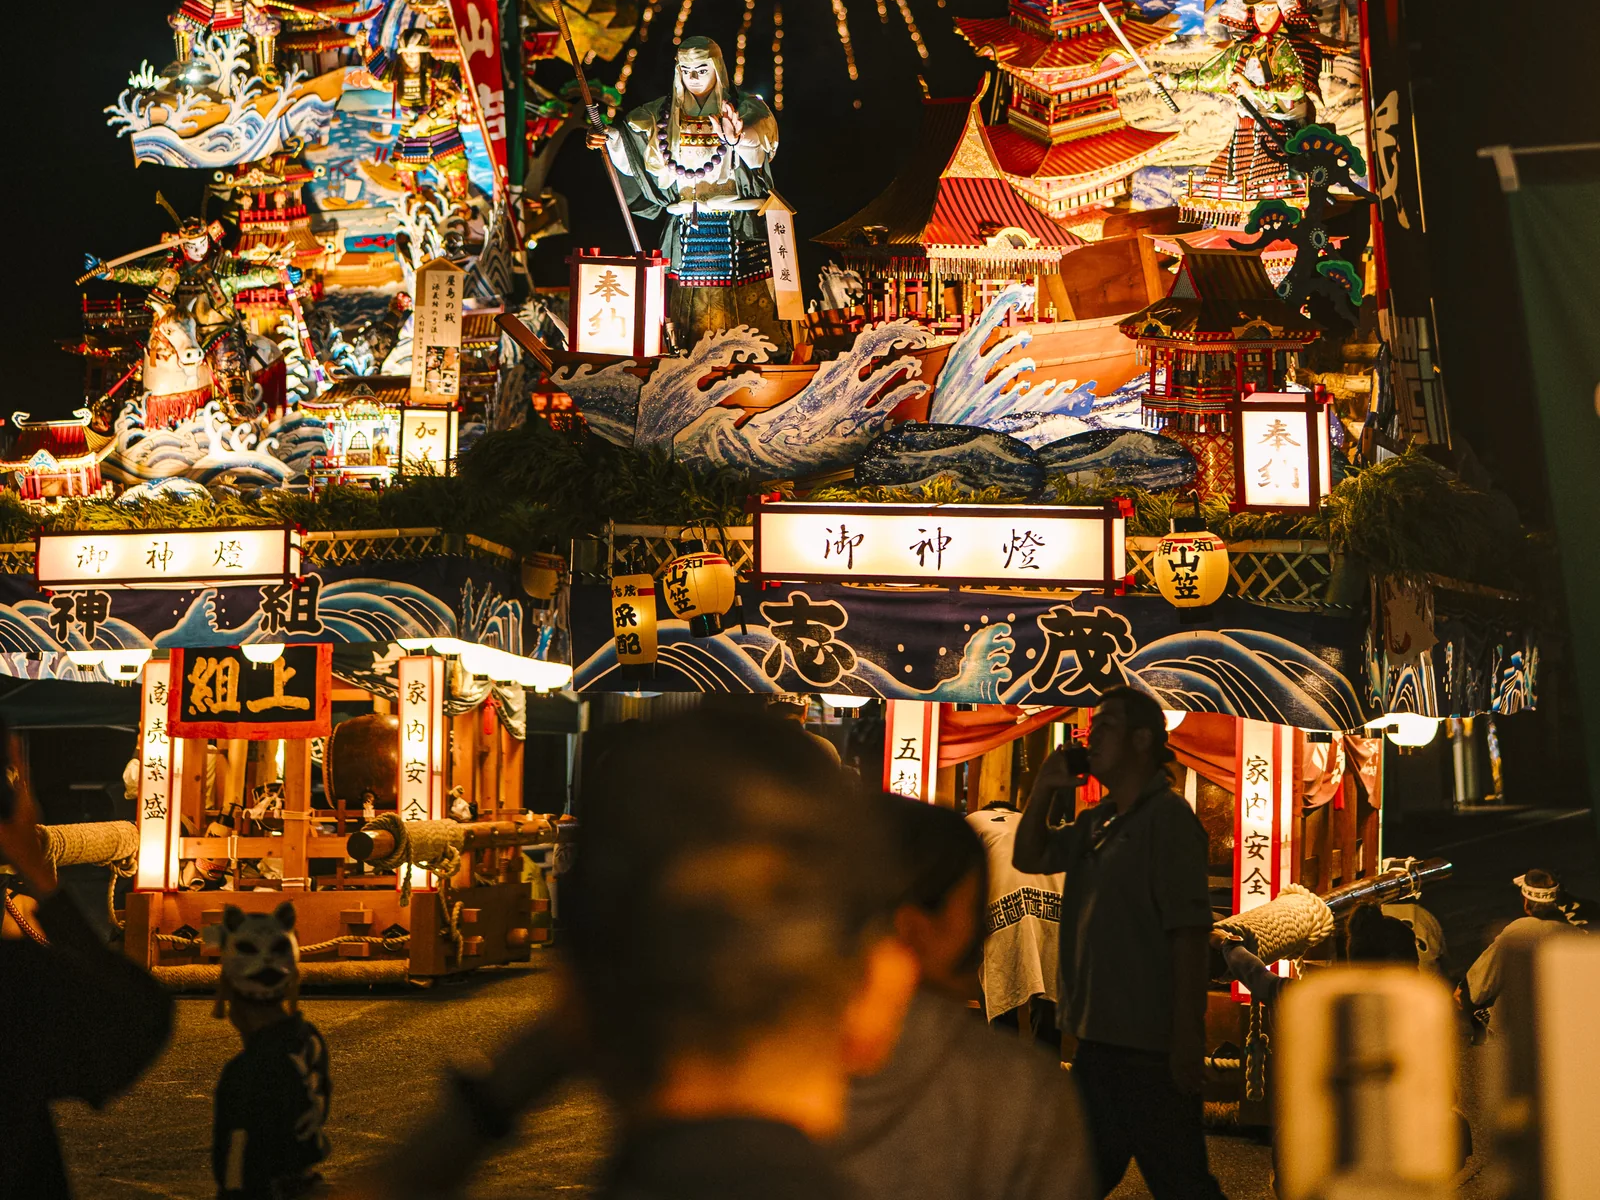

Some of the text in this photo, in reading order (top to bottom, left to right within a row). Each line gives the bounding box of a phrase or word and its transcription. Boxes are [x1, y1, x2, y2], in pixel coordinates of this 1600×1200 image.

[774, 222, 792, 283] 船弁慶
[588, 270, 630, 337] 奉納
[77, 540, 243, 573] 御神燈
[824, 523, 1046, 571] 御神燈
[1168, 546, 1200, 600] 山笠
[665, 564, 697, 615] 山笠
[144, 681, 169, 821] 商売繁盛
[401, 680, 428, 822] 家内安全
[1242, 755, 1272, 895] 家内安全
